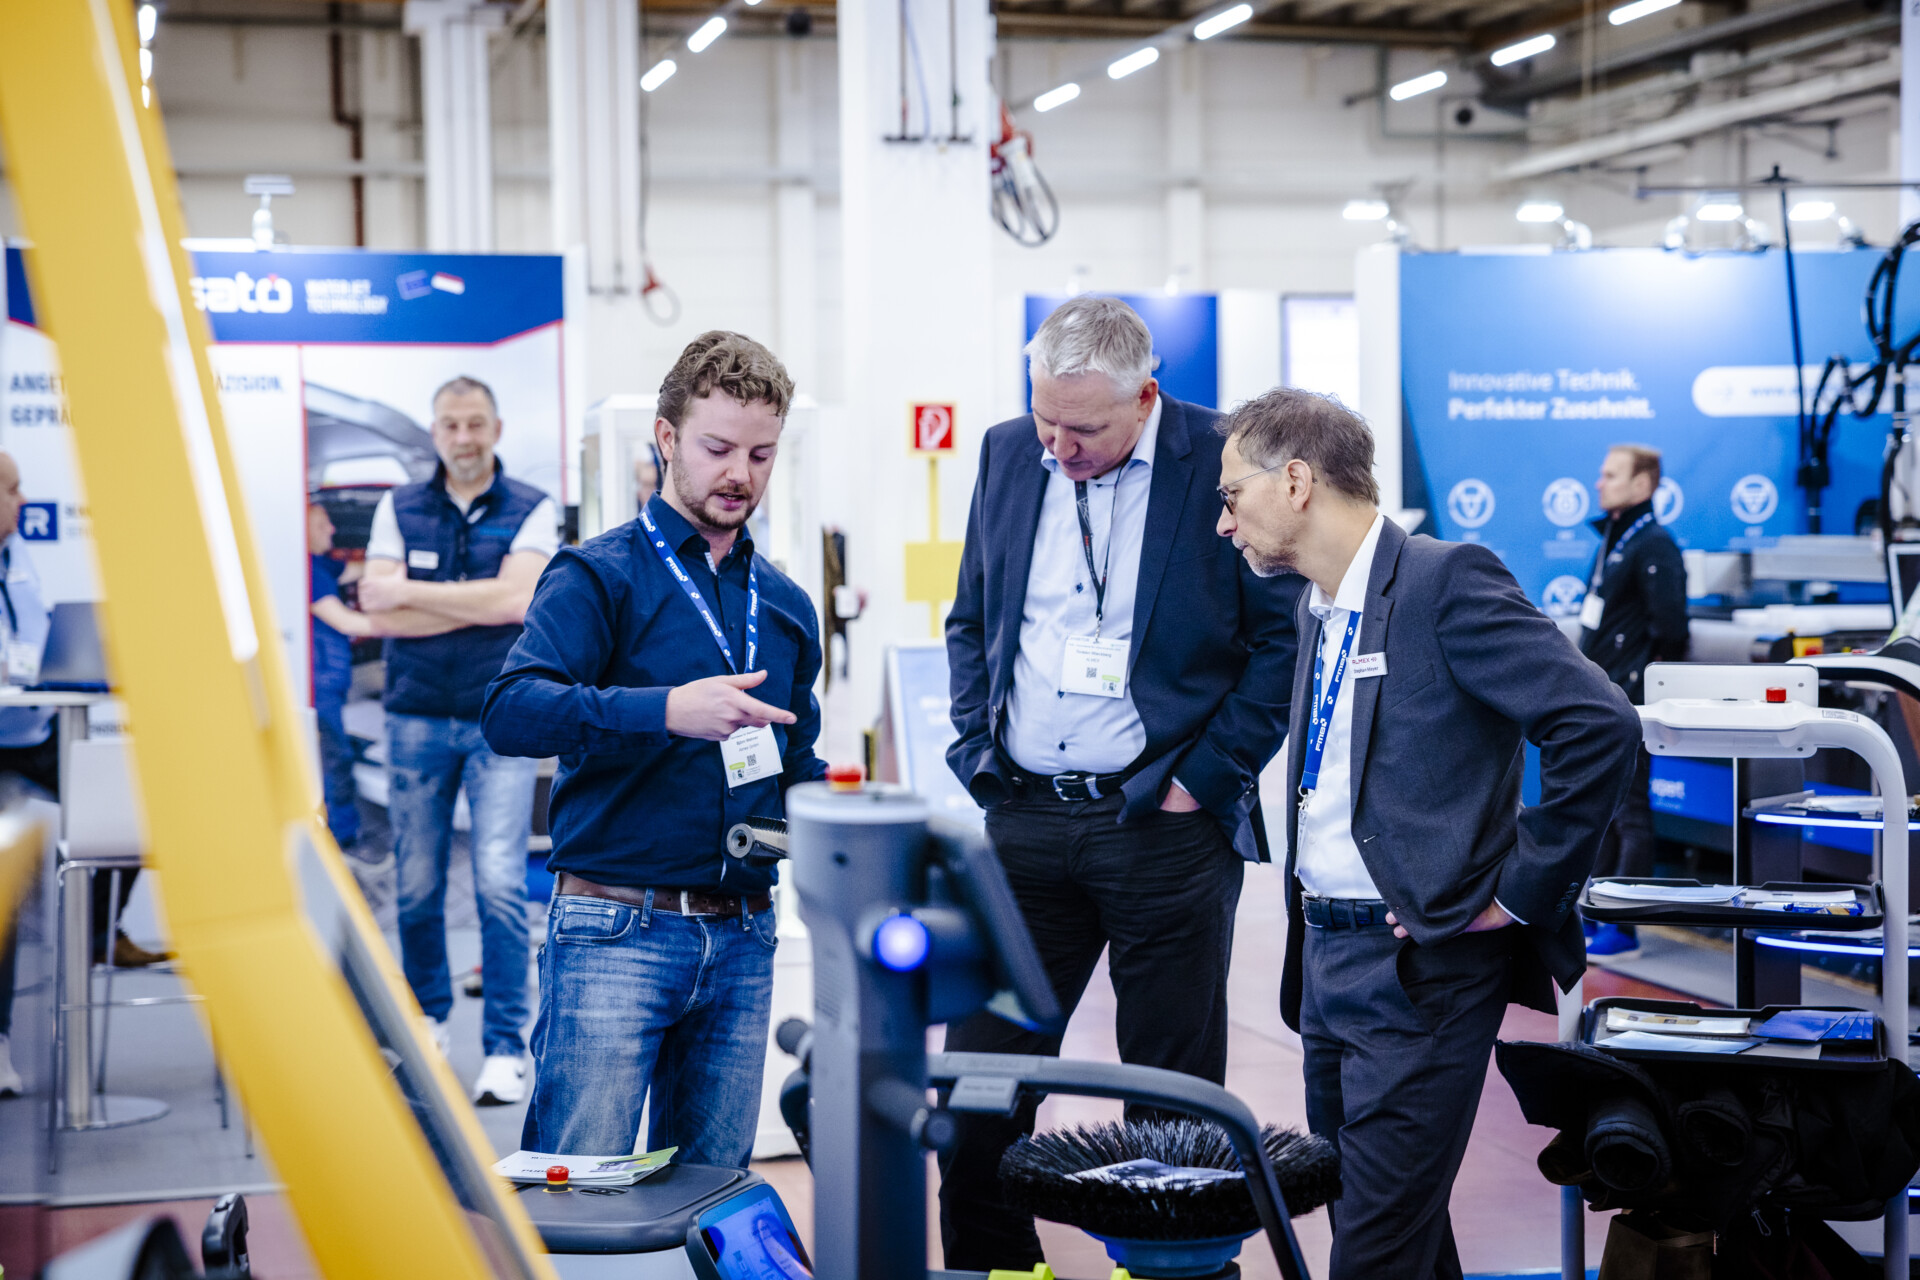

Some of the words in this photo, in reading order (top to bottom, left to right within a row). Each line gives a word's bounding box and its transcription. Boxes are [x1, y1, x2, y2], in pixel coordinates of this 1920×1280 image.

[189, 271, 293, 314] sato
[1448, 371, 1553, 392] Innovative
[1557, 368, 1640, 391] Technik.
[1448, 397, 1547, 420] Perfekter
[1550, 395, 1655, 420] Zuschnitt.
